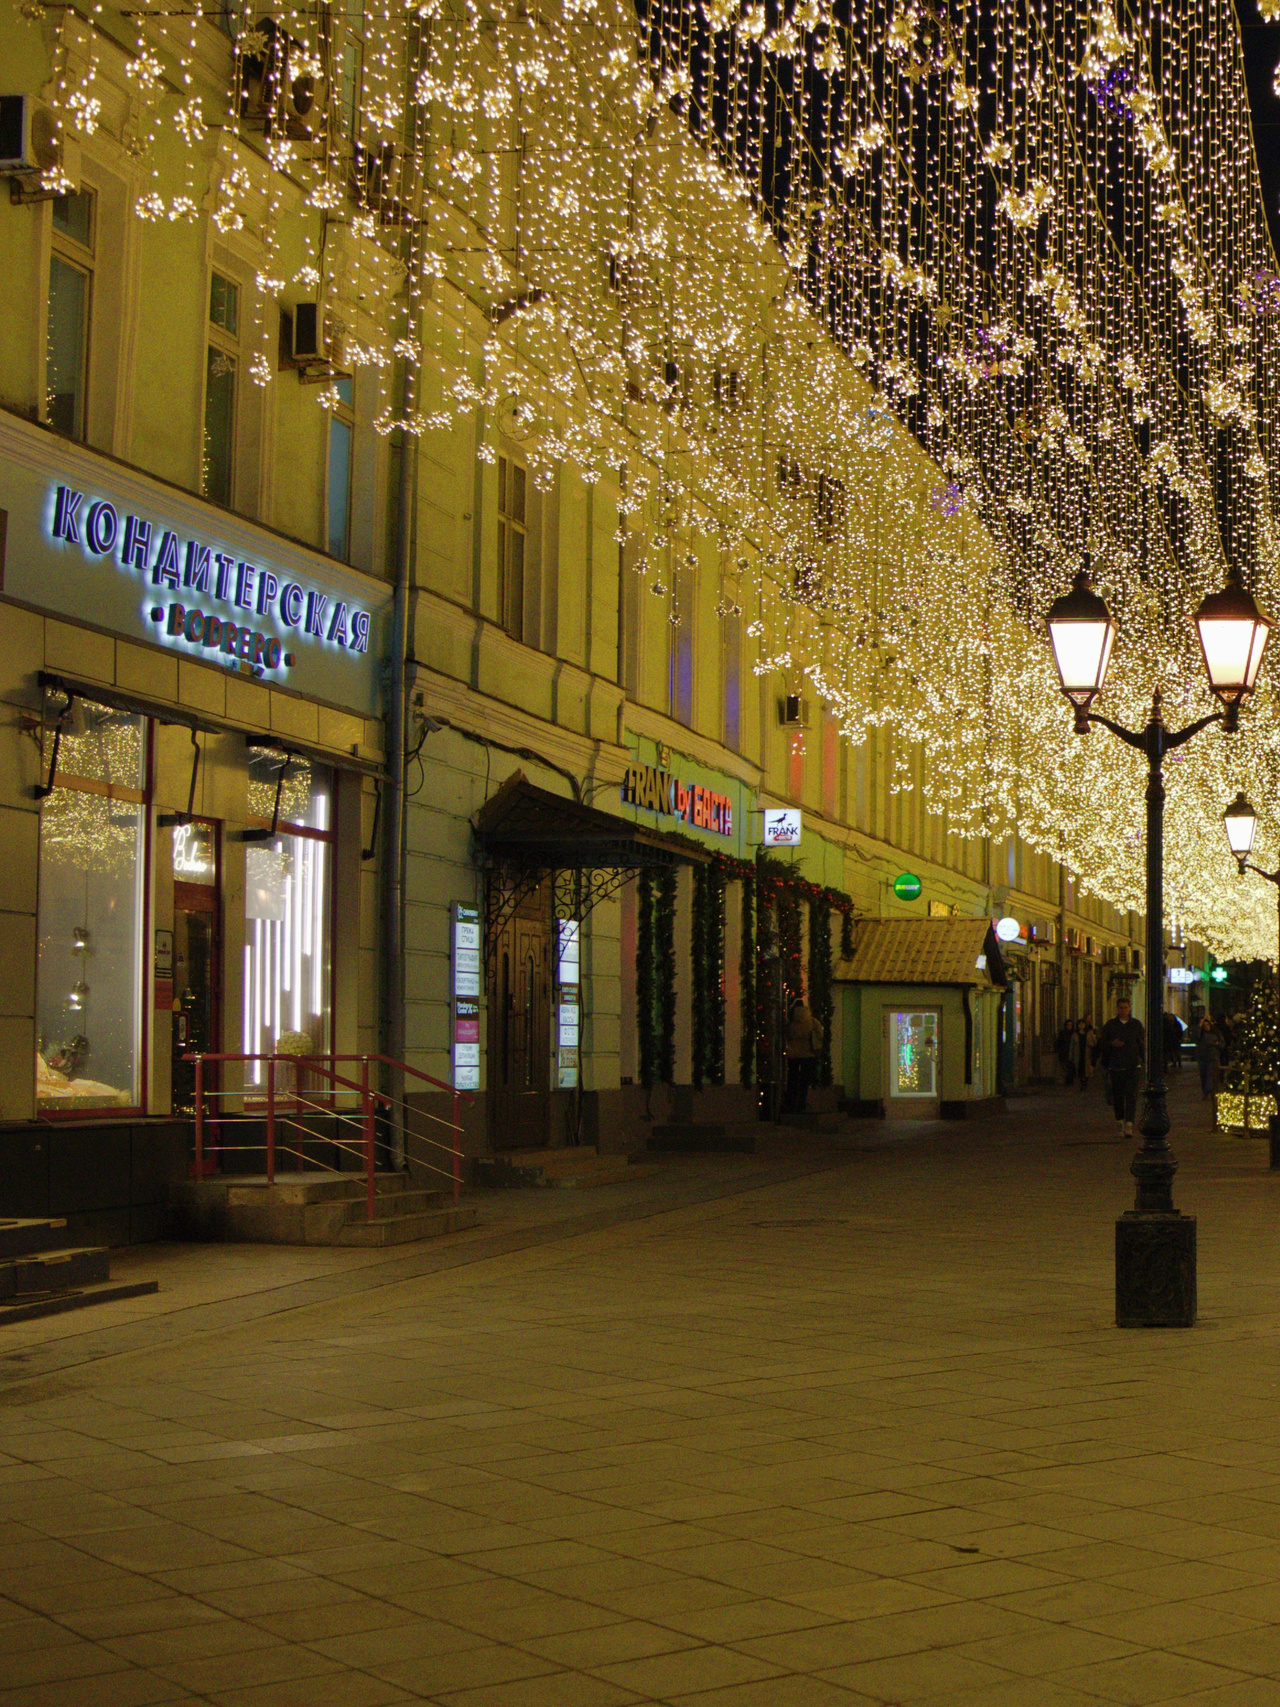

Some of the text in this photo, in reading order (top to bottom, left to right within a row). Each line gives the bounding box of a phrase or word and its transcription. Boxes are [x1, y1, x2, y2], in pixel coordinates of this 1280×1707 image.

[53, 486, 371, 653] КОНДИТЕРСКАЯ
[623, 760, 733, 837] FRANK by БАСТА
[768, 827, 798, 836] FRANK
